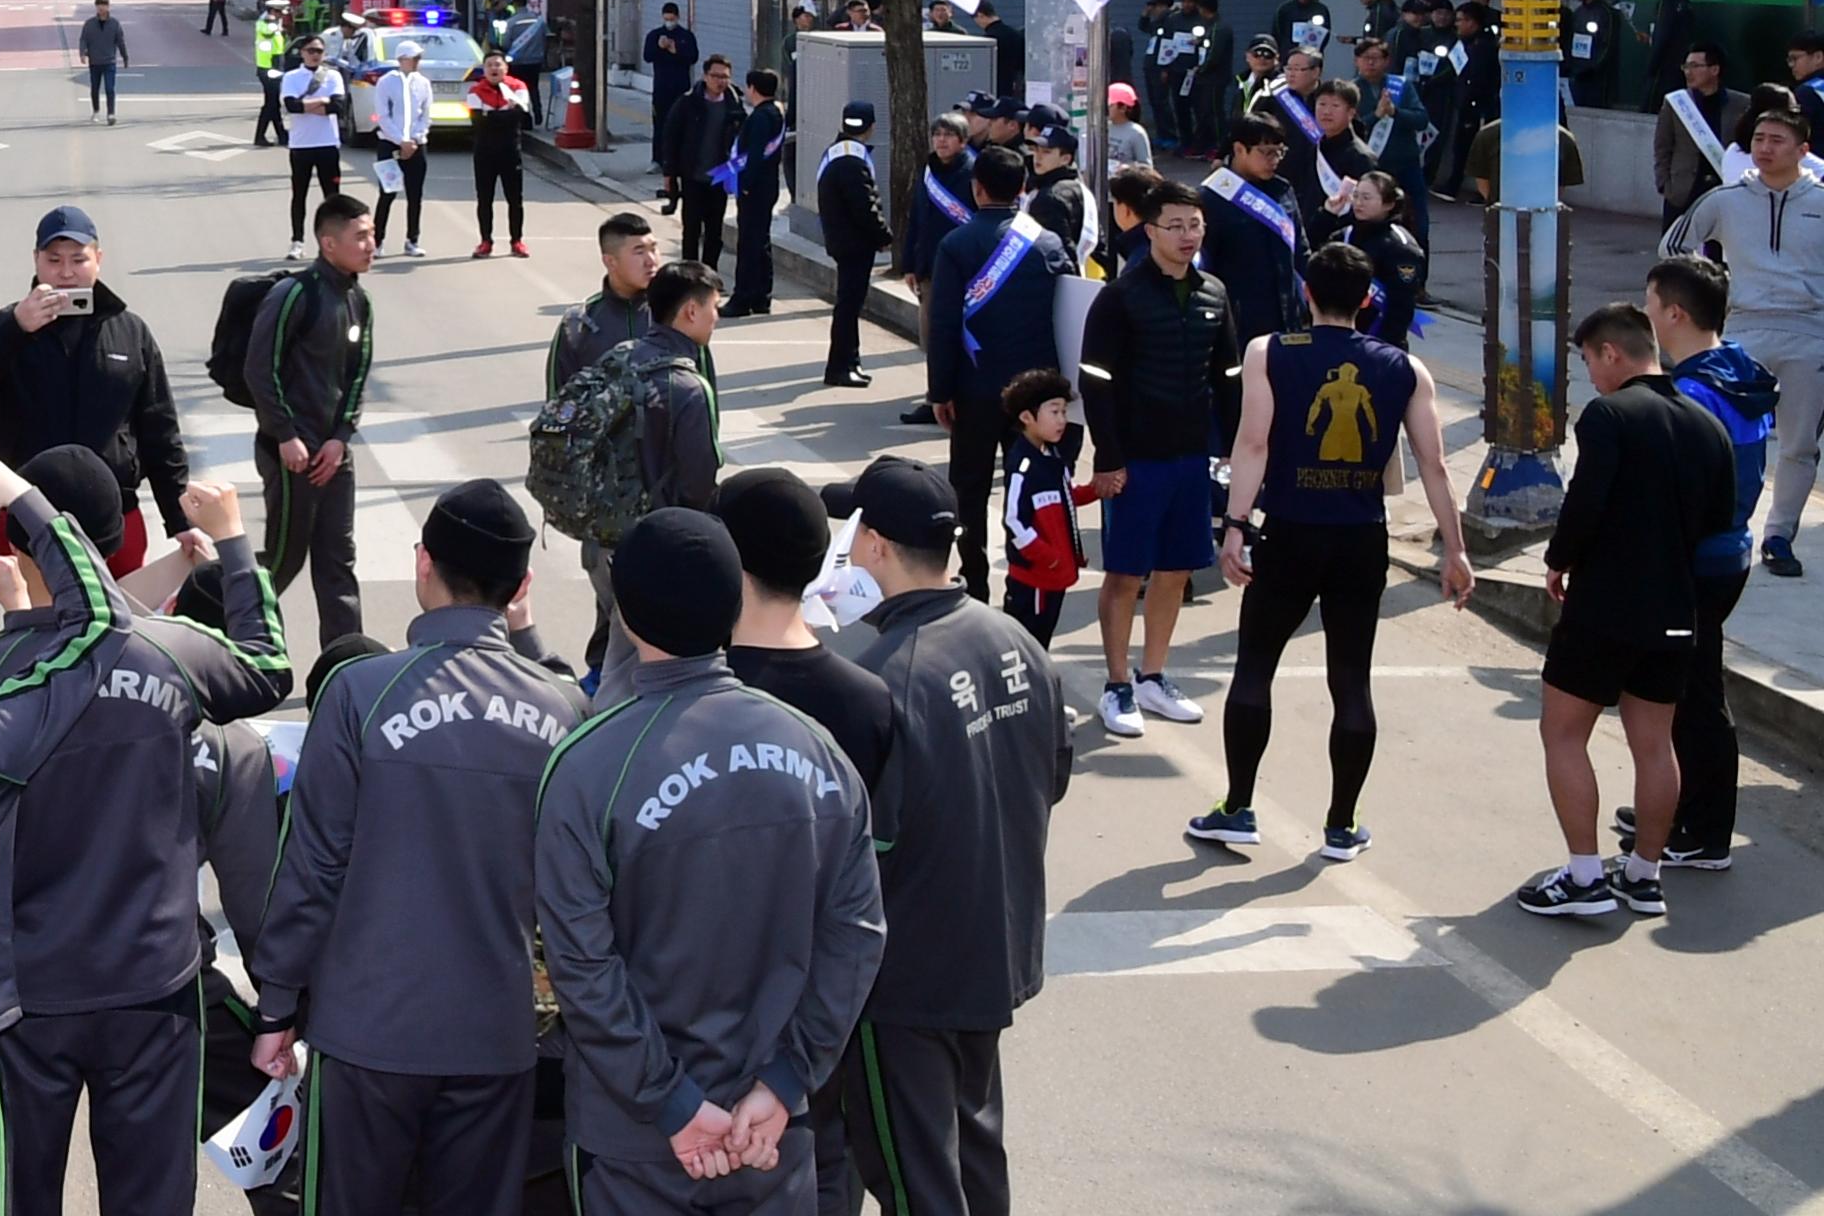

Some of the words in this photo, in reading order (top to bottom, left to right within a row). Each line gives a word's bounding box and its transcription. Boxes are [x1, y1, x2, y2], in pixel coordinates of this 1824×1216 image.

[948, 670, 979, 713] 육
[1000, 649, 1030, 695] 군
[993, 698, 1029, 721] TRUST
[380, 691, 470, 751] ROK
[483, 693, 568, 750] ARM
[636, 752, 718, 831] ROK
[728, 742, 842, 801] ARMY
